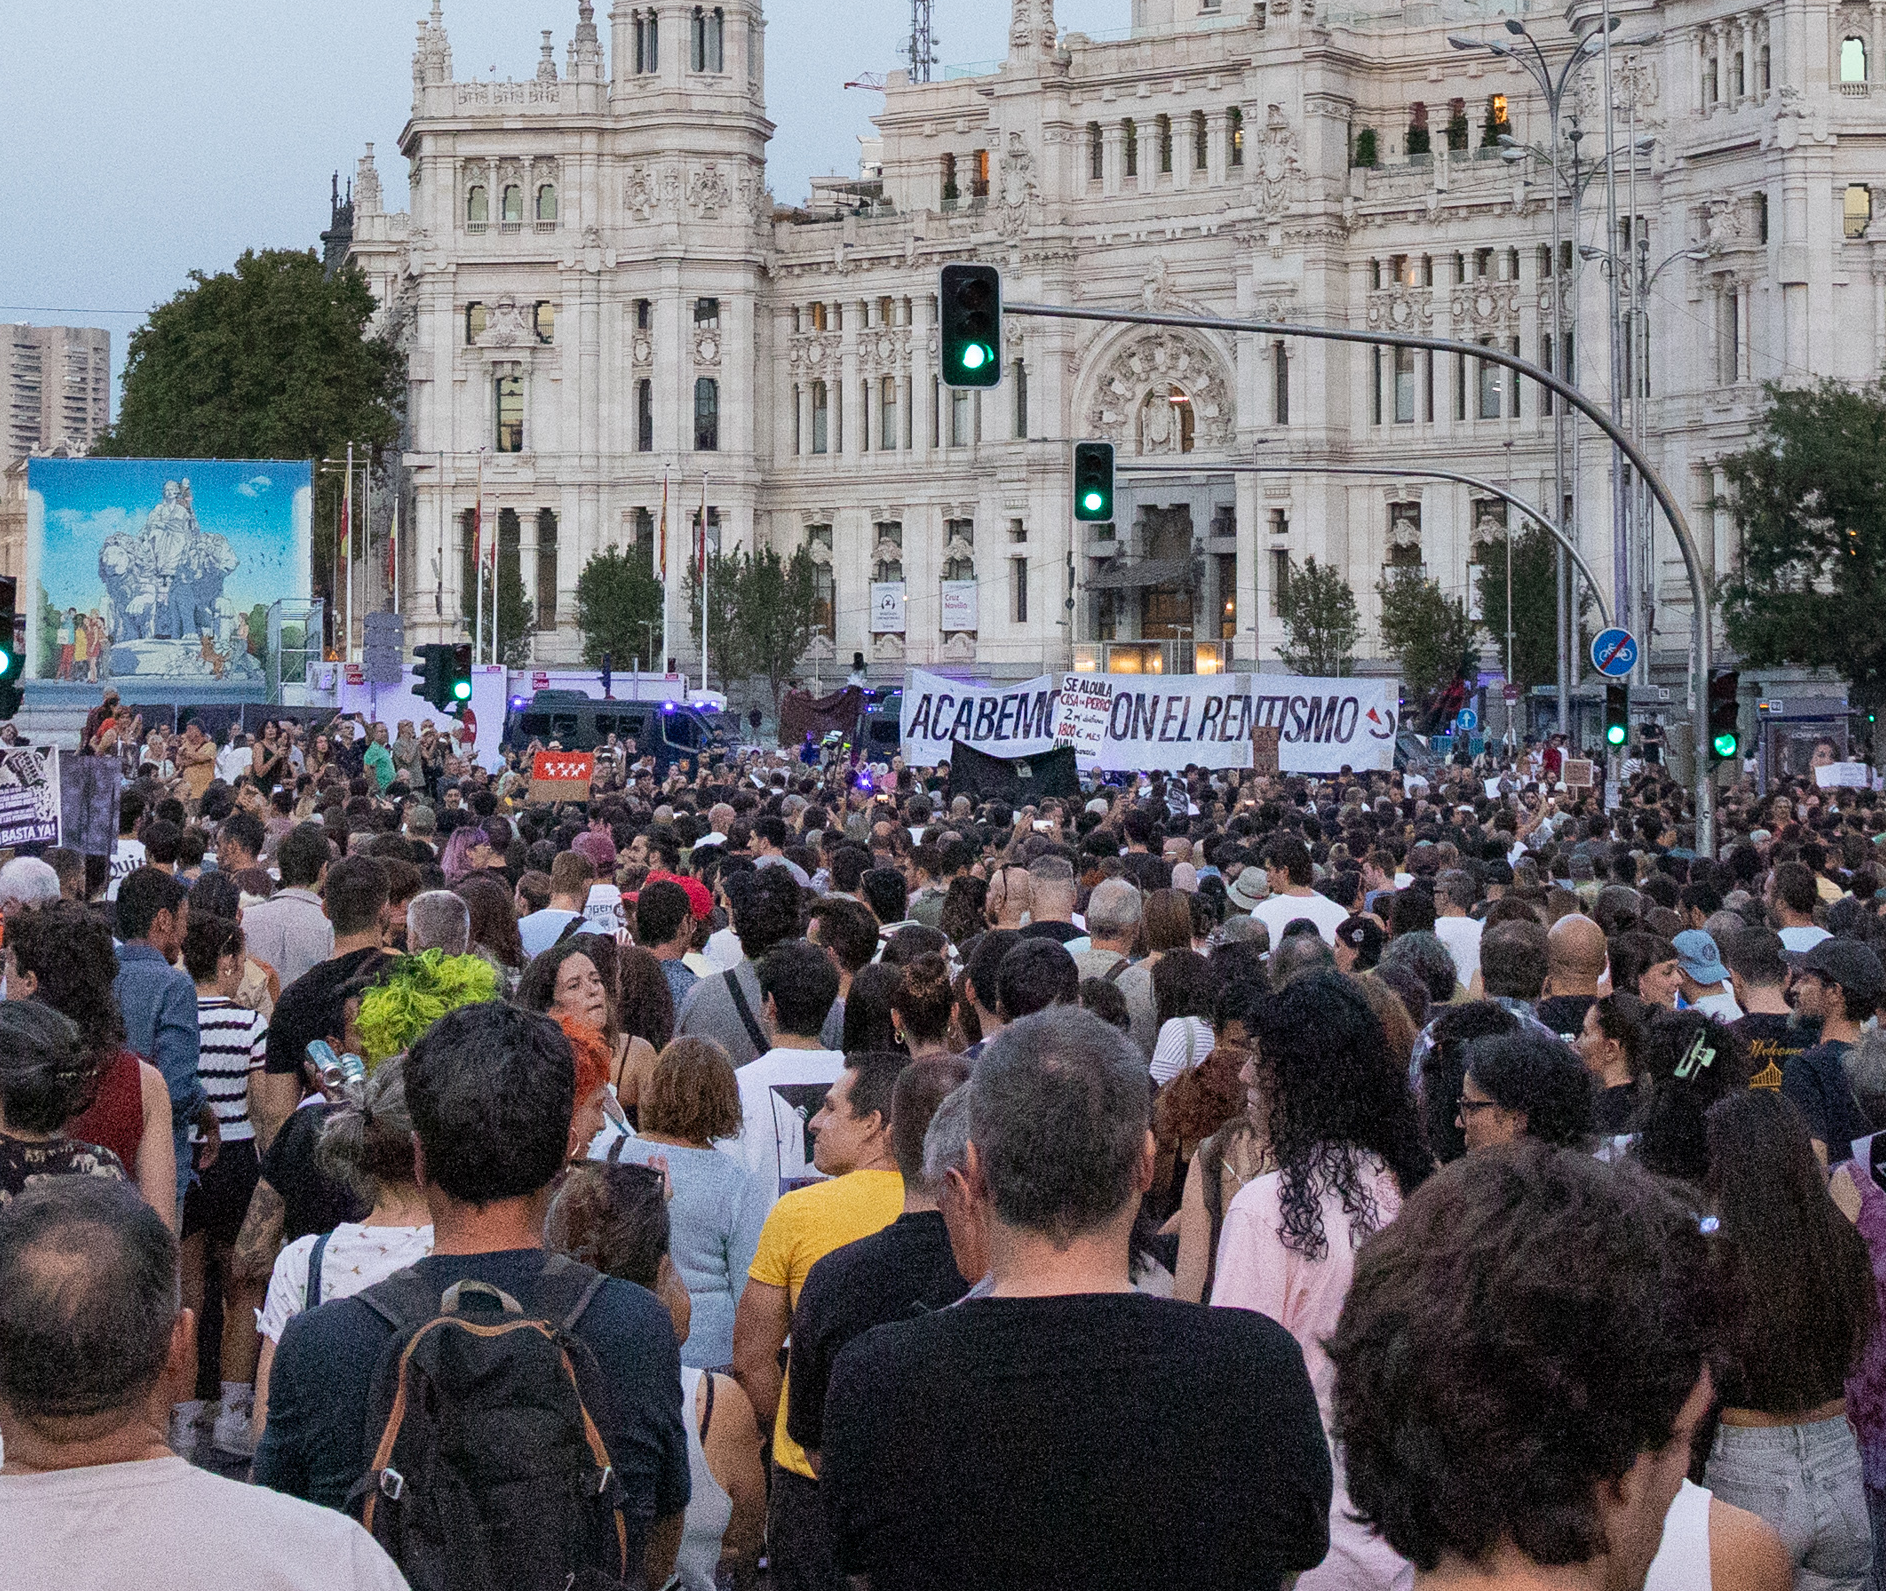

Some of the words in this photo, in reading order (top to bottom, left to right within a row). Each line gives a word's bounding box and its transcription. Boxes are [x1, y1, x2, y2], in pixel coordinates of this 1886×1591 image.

[944, 593, 960, 602] Cruz
[1064, 677, 1079, 692] SE
[1078, 679, 1112, 698] ALQUILA
[1060, 693, 1079, 707] CASA
[906, 689, 1061, 742] ACABEMO
[1103, 691, 1160, 742] ON
[1158, 695, 1192, 743] EL
[1196, 693, 1359, 744] RENTISMO
[1064, 708, 1073, 720] 2
[1058, 721, 1076, 738] 1800
[36, 823, 56, 839] YA!
